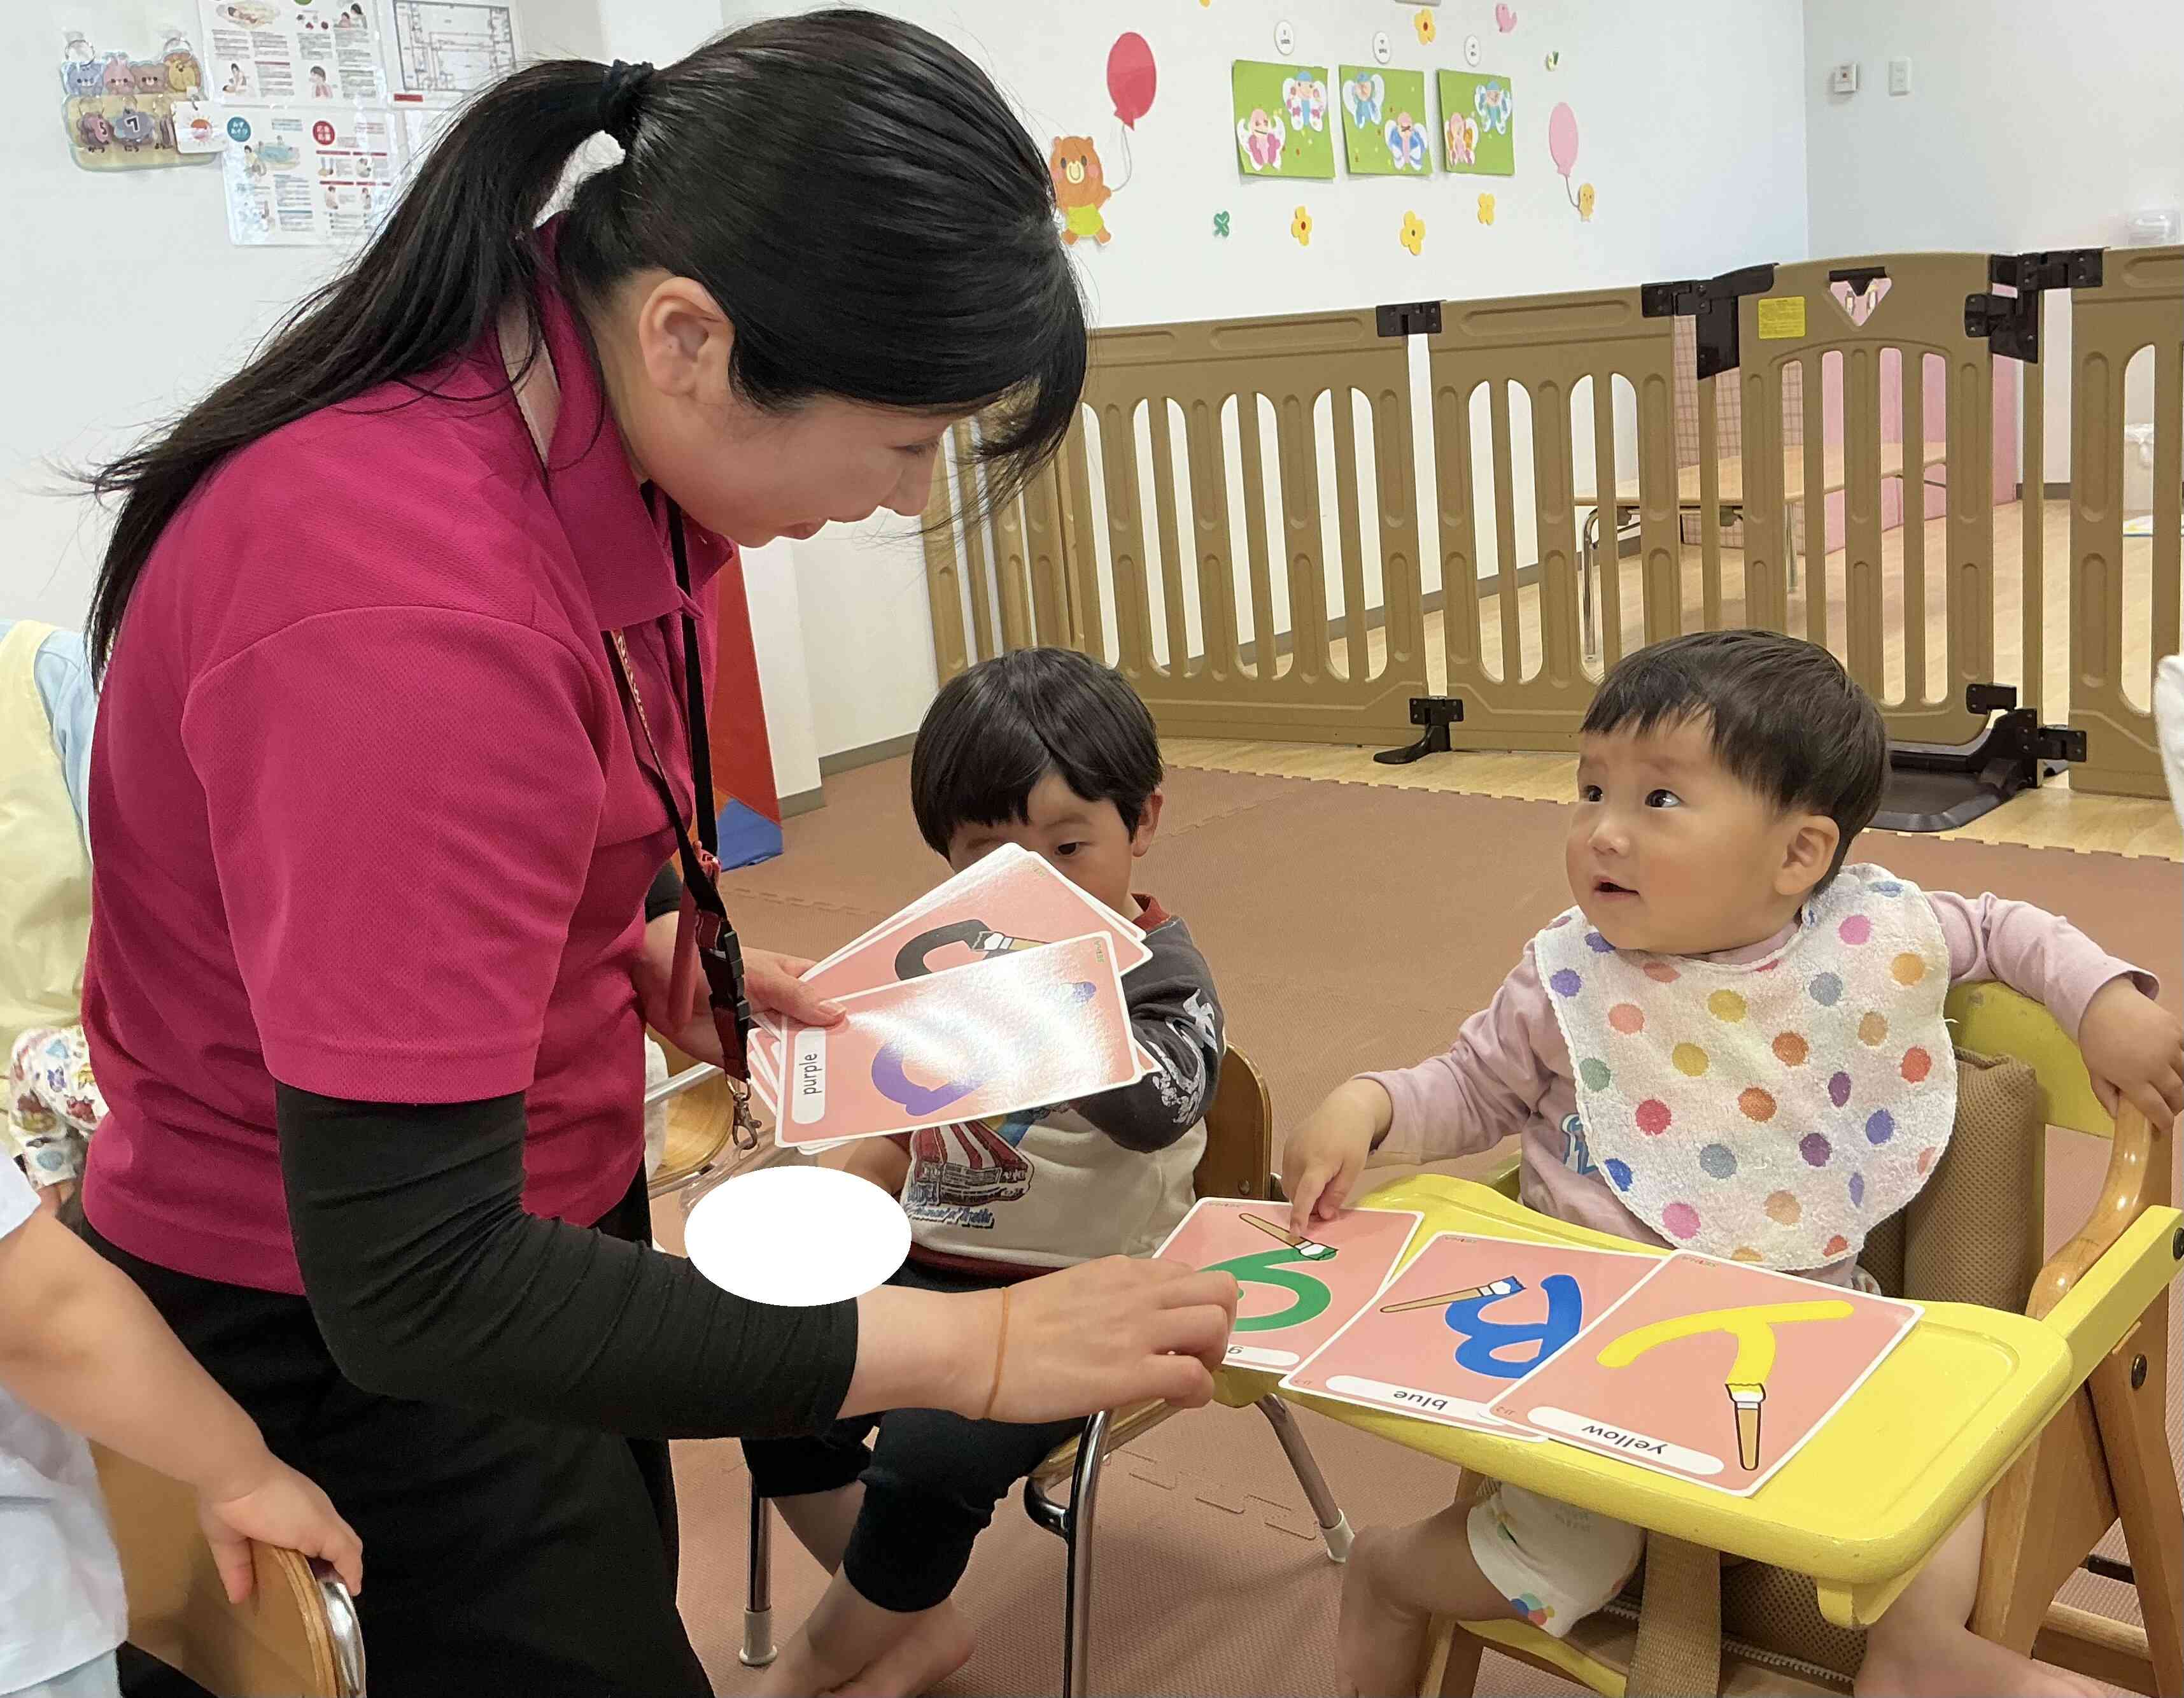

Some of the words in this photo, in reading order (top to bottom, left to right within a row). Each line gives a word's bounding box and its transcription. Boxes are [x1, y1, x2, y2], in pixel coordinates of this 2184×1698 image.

[125, 116, 139, 132] 7
[799, 1053, 823, 1095] purple
[1393, 1390, 1449, 1411] blue
[1581, 1424, 1669, 1455] yellow
